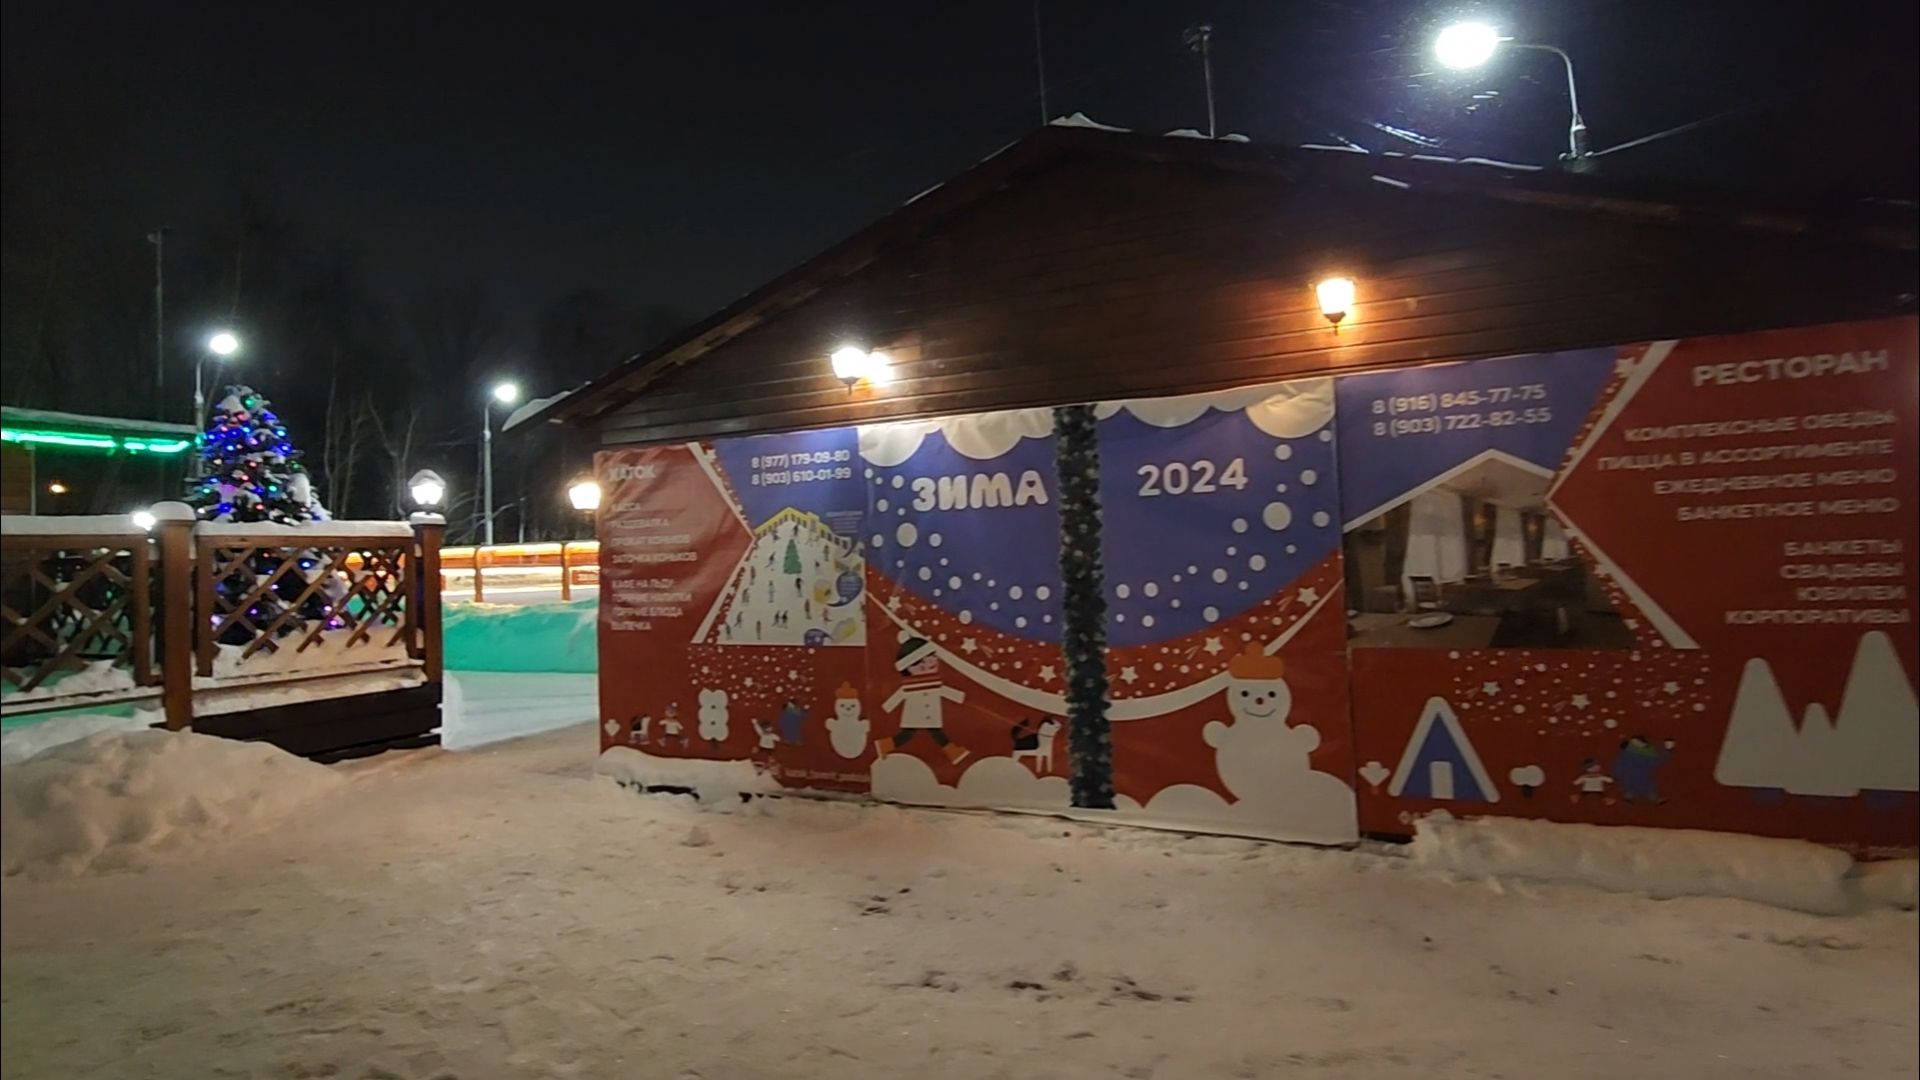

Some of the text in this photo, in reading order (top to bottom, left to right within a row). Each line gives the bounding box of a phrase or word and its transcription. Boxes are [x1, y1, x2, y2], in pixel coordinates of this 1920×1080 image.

[1693, 350, 1889, 386] РЕСТОРАН
[1372, 384, 1547, 415] 8 (916) 845-77-75
[1373, 407, 1552, 437] 8 (903) 722-82-55
[1625, 410, 1897, 442] КОМПЛЕКСНЫЕ ОБЕДЫ
[752, 457, 760, 469] 8
[762, 453, 789, 470] (977)
[1680, 452, 1695, 466] В
[1701, 439, 1894, 464] АССОРТИМЕНТЕ
[752, 474, 760, 485] 8
[762, 470, 791, 487] (903)
[911, 470, 1048, 511] ЗИМА
[1136, 458, 1248, 496] 2024
[1654, 469, 1897, 495] ЕЖЕДНЕВНОЕ МЕНЮ
[1677, 497, 1899, 521] БАНКЕТНОЕ МЕНЮ
[1784, 539, 1902, 556] БАНКЕТЫ
[1780, 562, 1904, 580] СВАДЬБЫ
